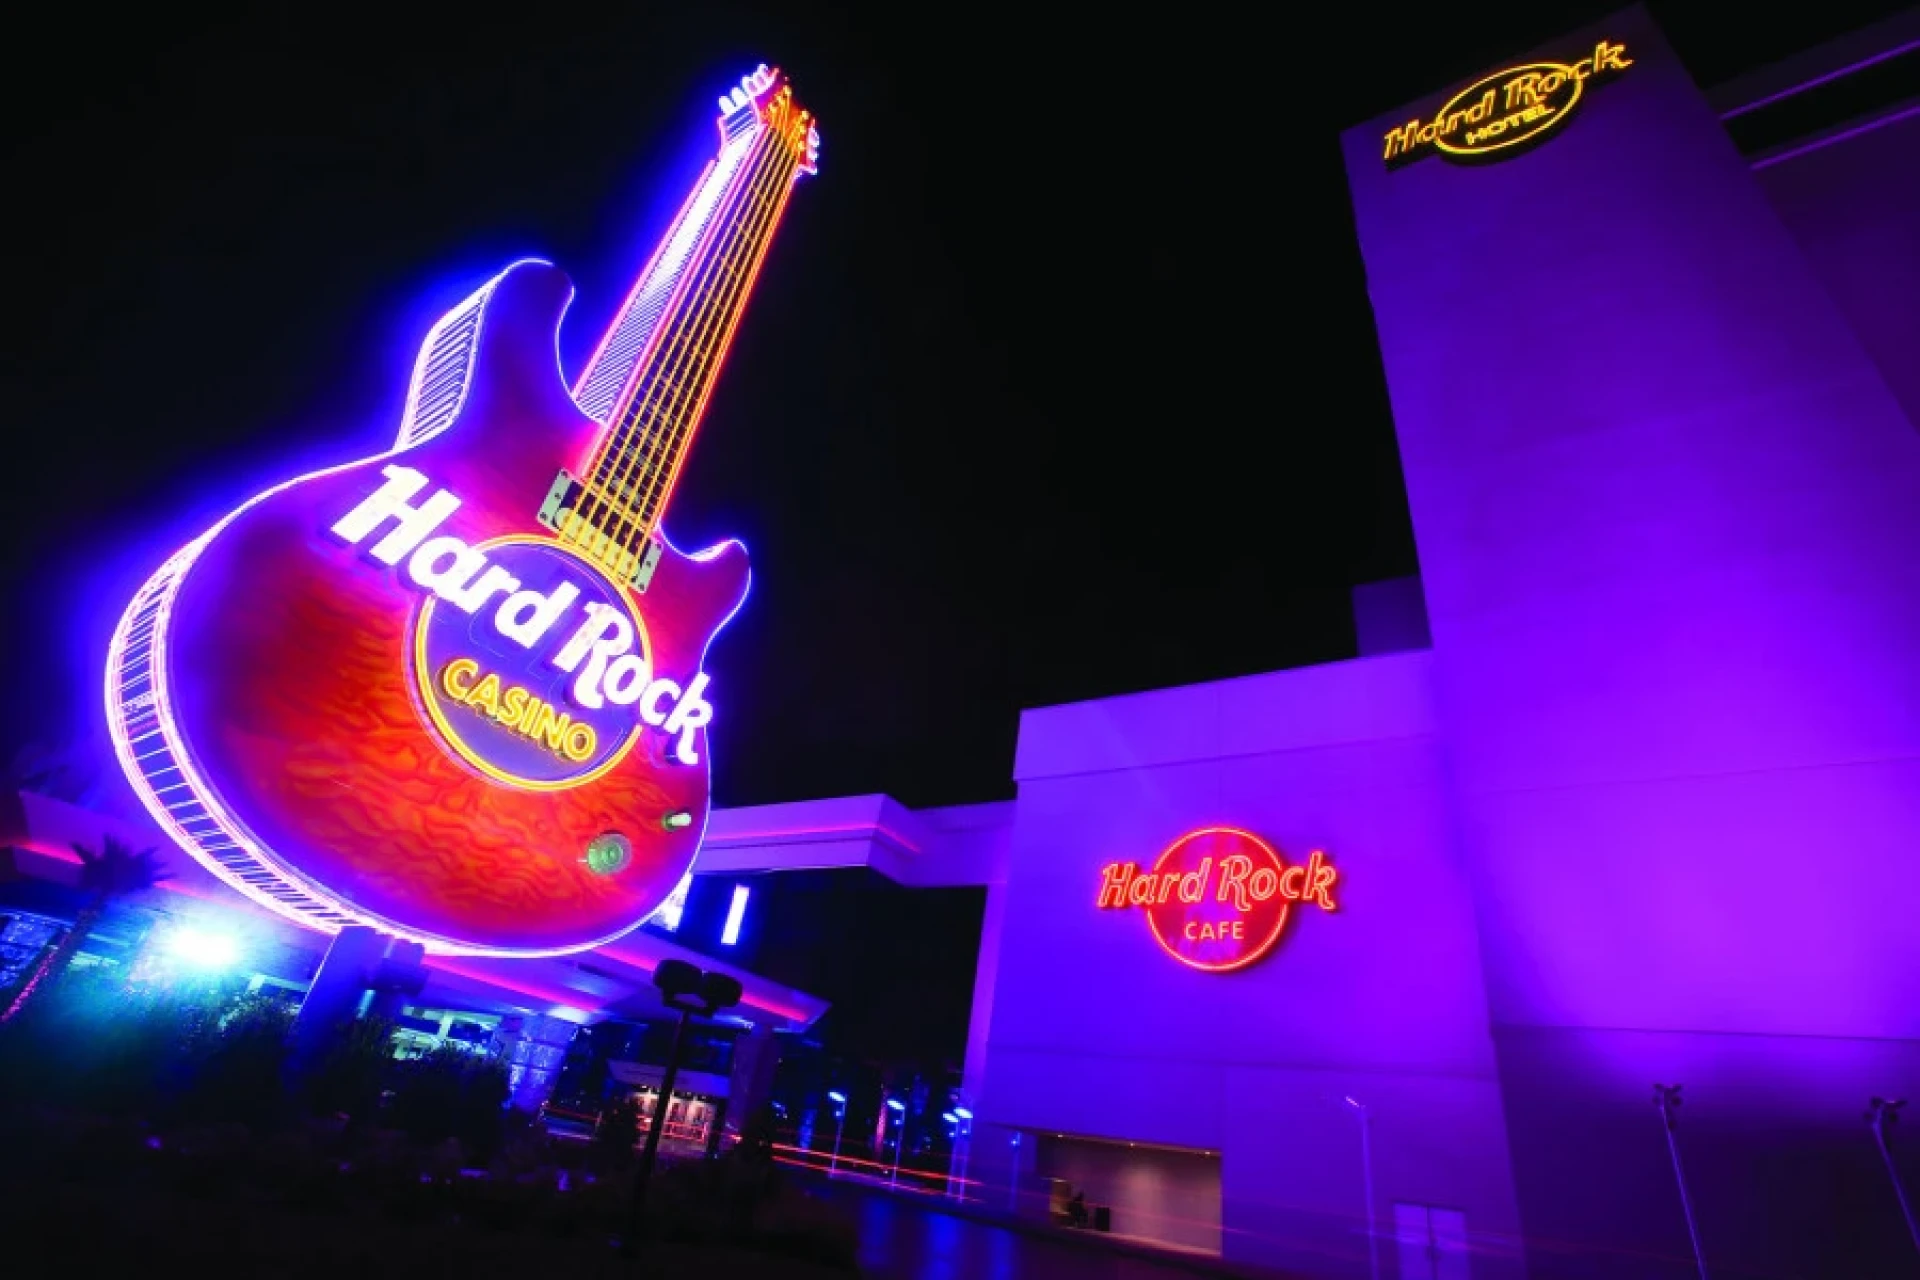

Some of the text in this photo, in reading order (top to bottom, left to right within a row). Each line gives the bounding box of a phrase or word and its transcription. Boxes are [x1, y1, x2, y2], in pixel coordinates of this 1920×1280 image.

[1384, 41, 1634, 160] Hard Rock
[1465, 104, 1555, 145] HOTEL
[330, 464, 713, 765] Hard Rock
[442, 657, 597, 763] CASINO
[1097, 850, 1337, 912] Hard Rock
[1184, 921, 1245, 940] CAFE
